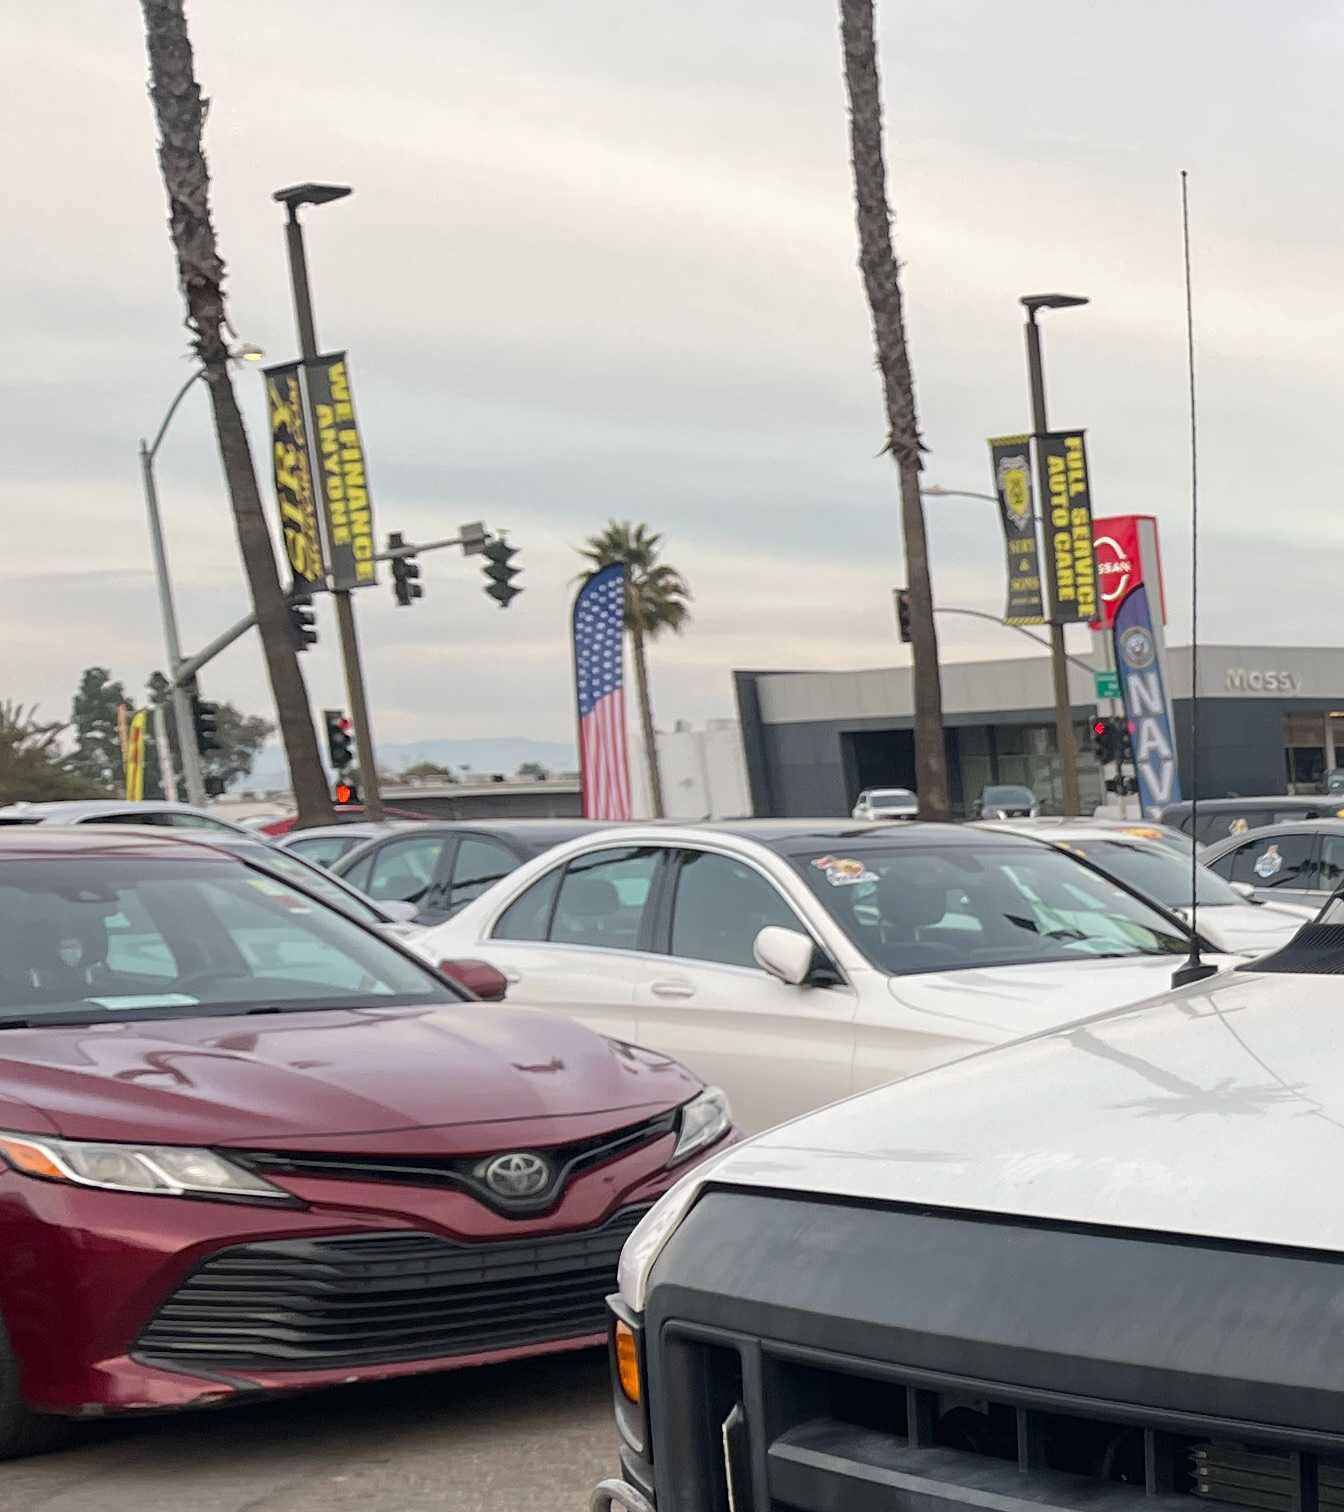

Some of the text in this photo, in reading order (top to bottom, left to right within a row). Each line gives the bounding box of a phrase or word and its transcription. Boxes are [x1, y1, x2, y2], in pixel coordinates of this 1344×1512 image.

[316, 404, 350, 545] ANYONE
[328, 361, 373, 581] WE FINANCE
[1047, 456, 1075, 601] AUTO CARE
[1064, 436, 1095, 617] FULL SERVICE
[1128, 672, 1174, 816] NAV
